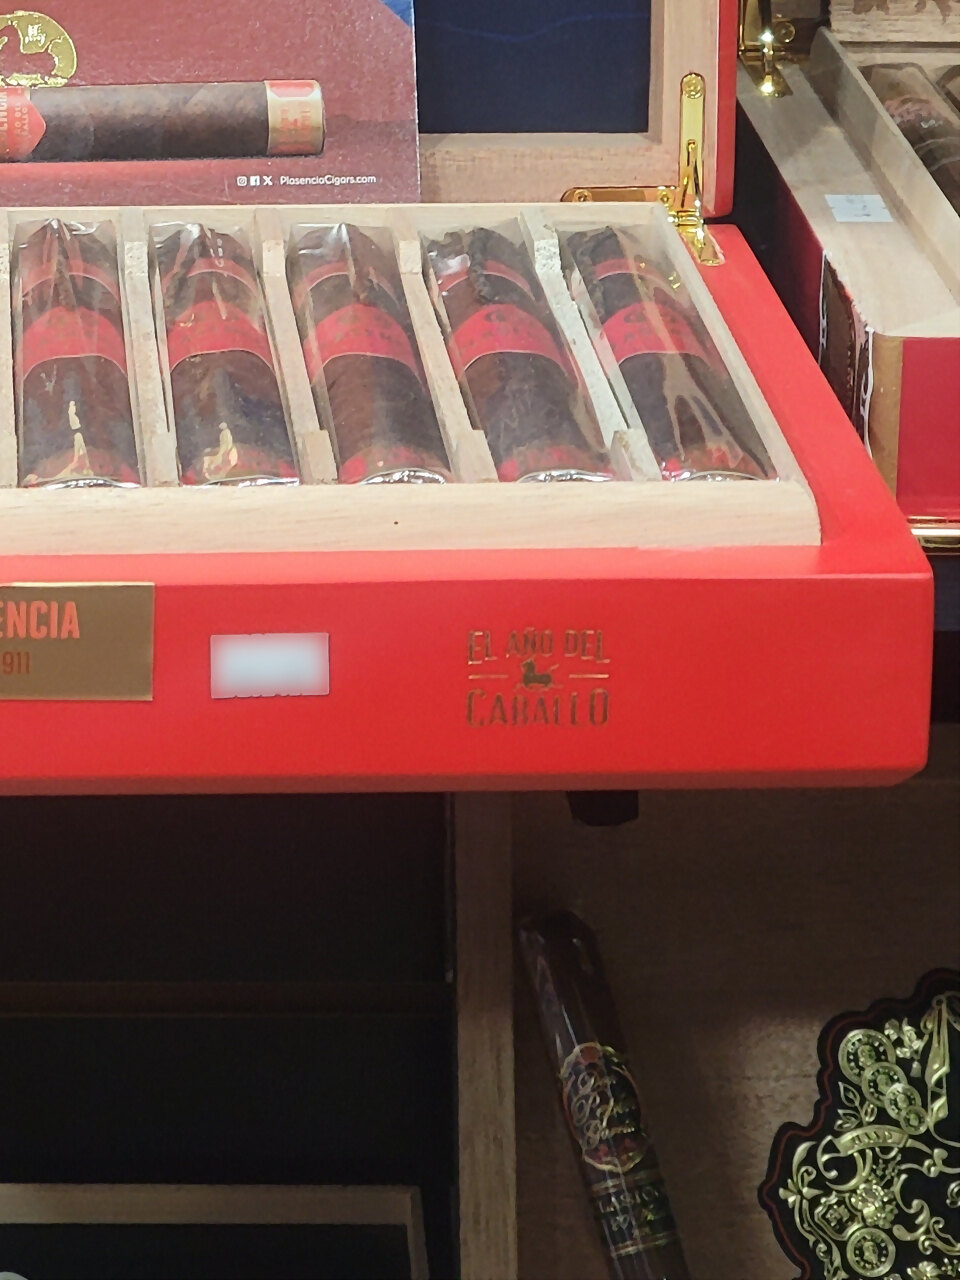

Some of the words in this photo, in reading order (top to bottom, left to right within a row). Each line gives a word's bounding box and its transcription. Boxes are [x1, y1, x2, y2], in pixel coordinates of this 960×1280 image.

[279, 175, 377, 186] PlasenciaCigars.com
[467, 630, 498, 666] EL
[505, 626, 554, 659] AÑO
[564, 629, 612, 664] DEL
[466, 687, 610, 728] CABALLO
